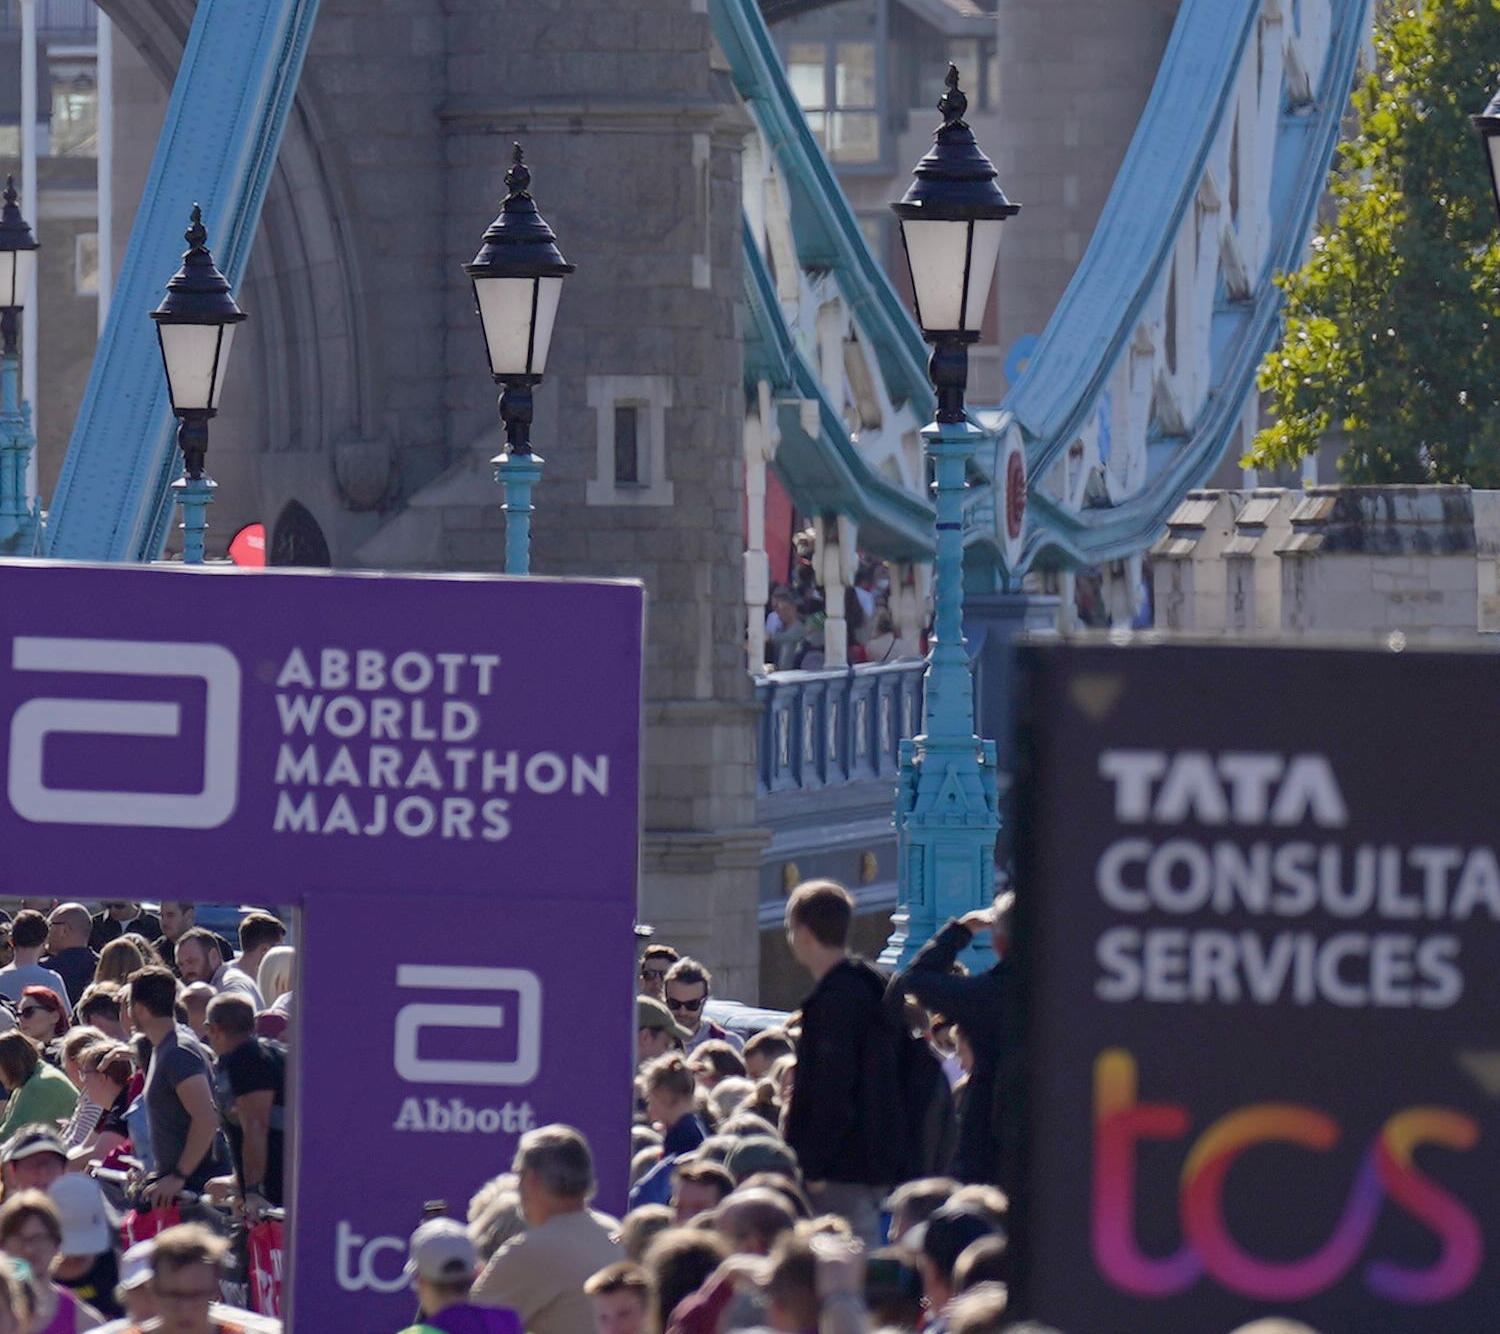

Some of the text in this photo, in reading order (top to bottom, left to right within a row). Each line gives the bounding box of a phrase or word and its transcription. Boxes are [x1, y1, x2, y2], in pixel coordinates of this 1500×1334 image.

[276, 648, 500, 696] ABBOTT
[277, 695, 480, 743] WORLD
[273, 744, 610, 797] MARATHON
[1098, 750, 1349, 827] TATA
[273, 792, 511, 842] MAJORS
[1095, 927, 1464, 1009] SERVICES
[394, 1098, 535, 1134] Abbott
[1091, 1047, 1485, 1304] tcs
[336, 1221, 410, 1292] tc
